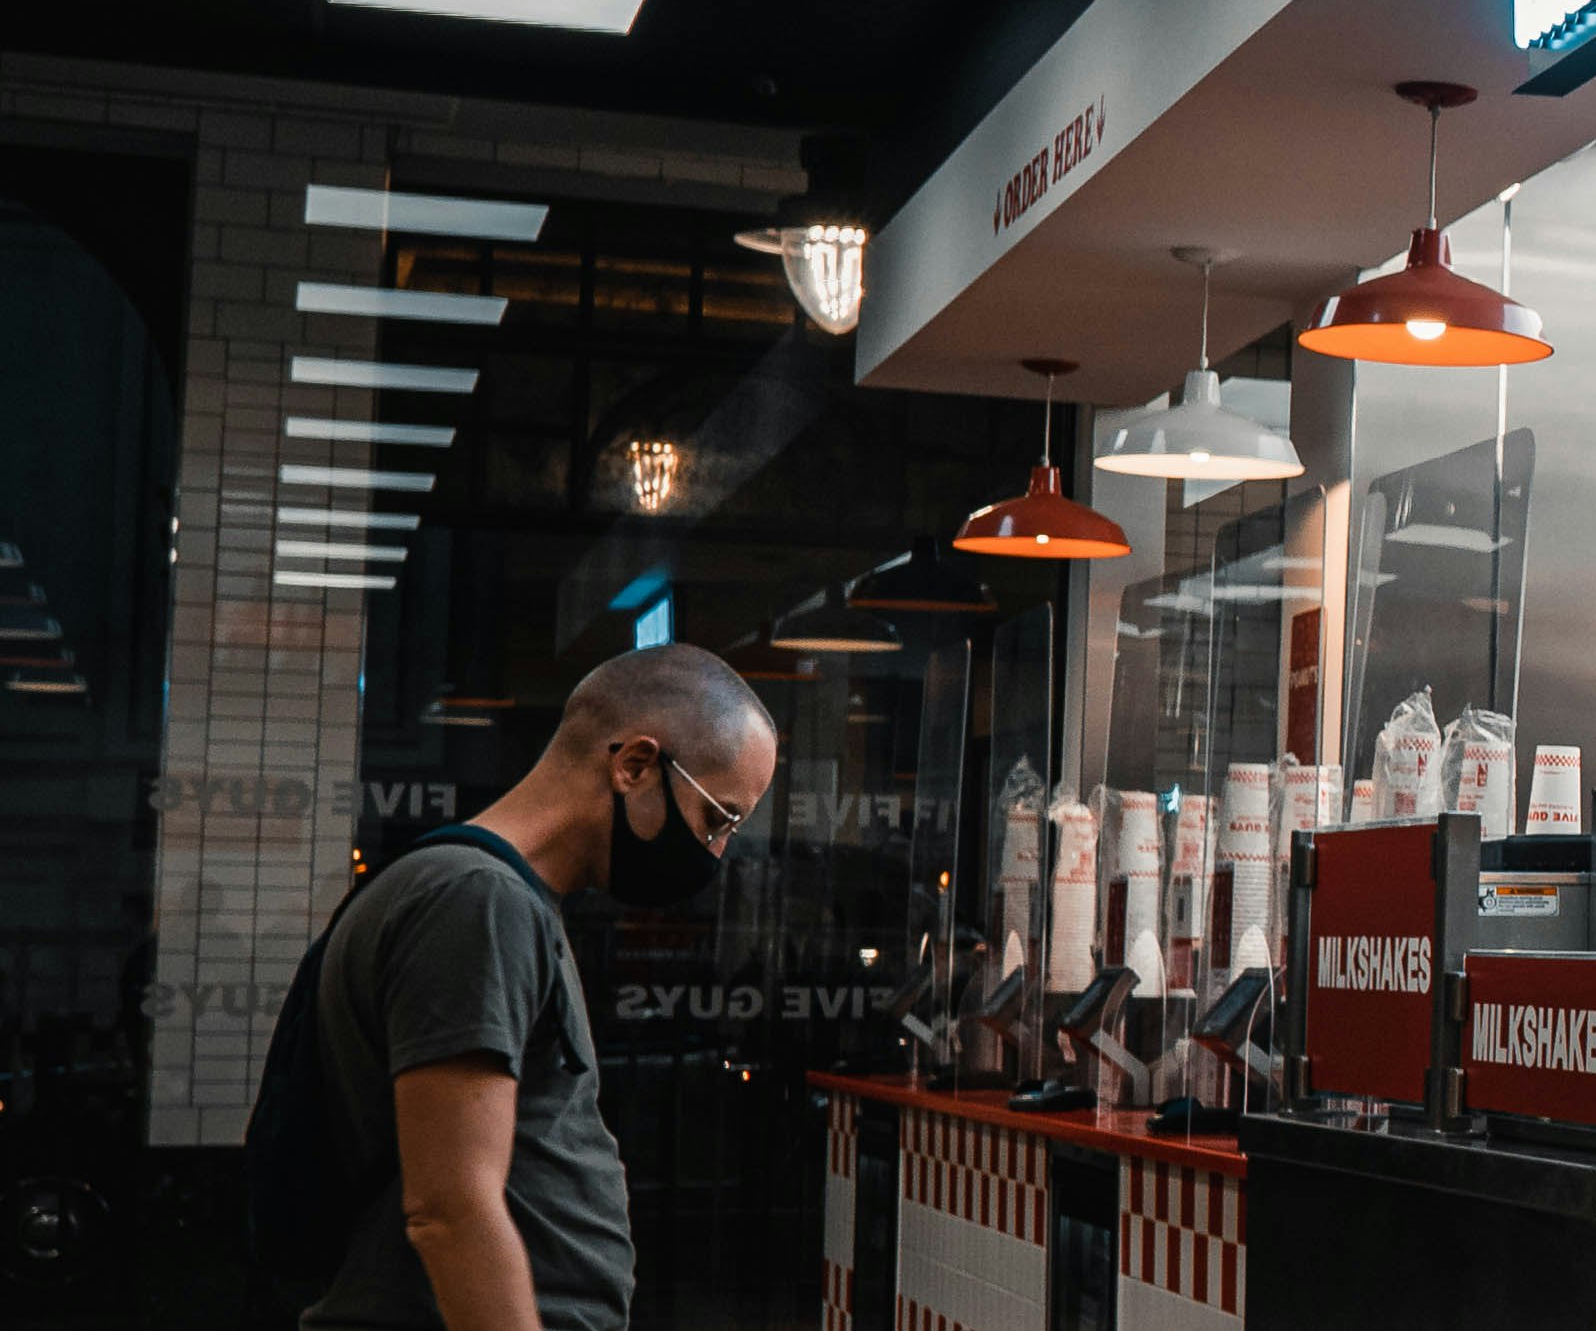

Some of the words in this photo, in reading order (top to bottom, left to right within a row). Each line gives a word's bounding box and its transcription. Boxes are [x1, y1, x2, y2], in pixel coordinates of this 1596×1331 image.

[1003, 145, 1048, 229] ORDER
[1052, 103, 1094, 185] HERE
[1318, 934, 1432, 995] MILKSHAKES
